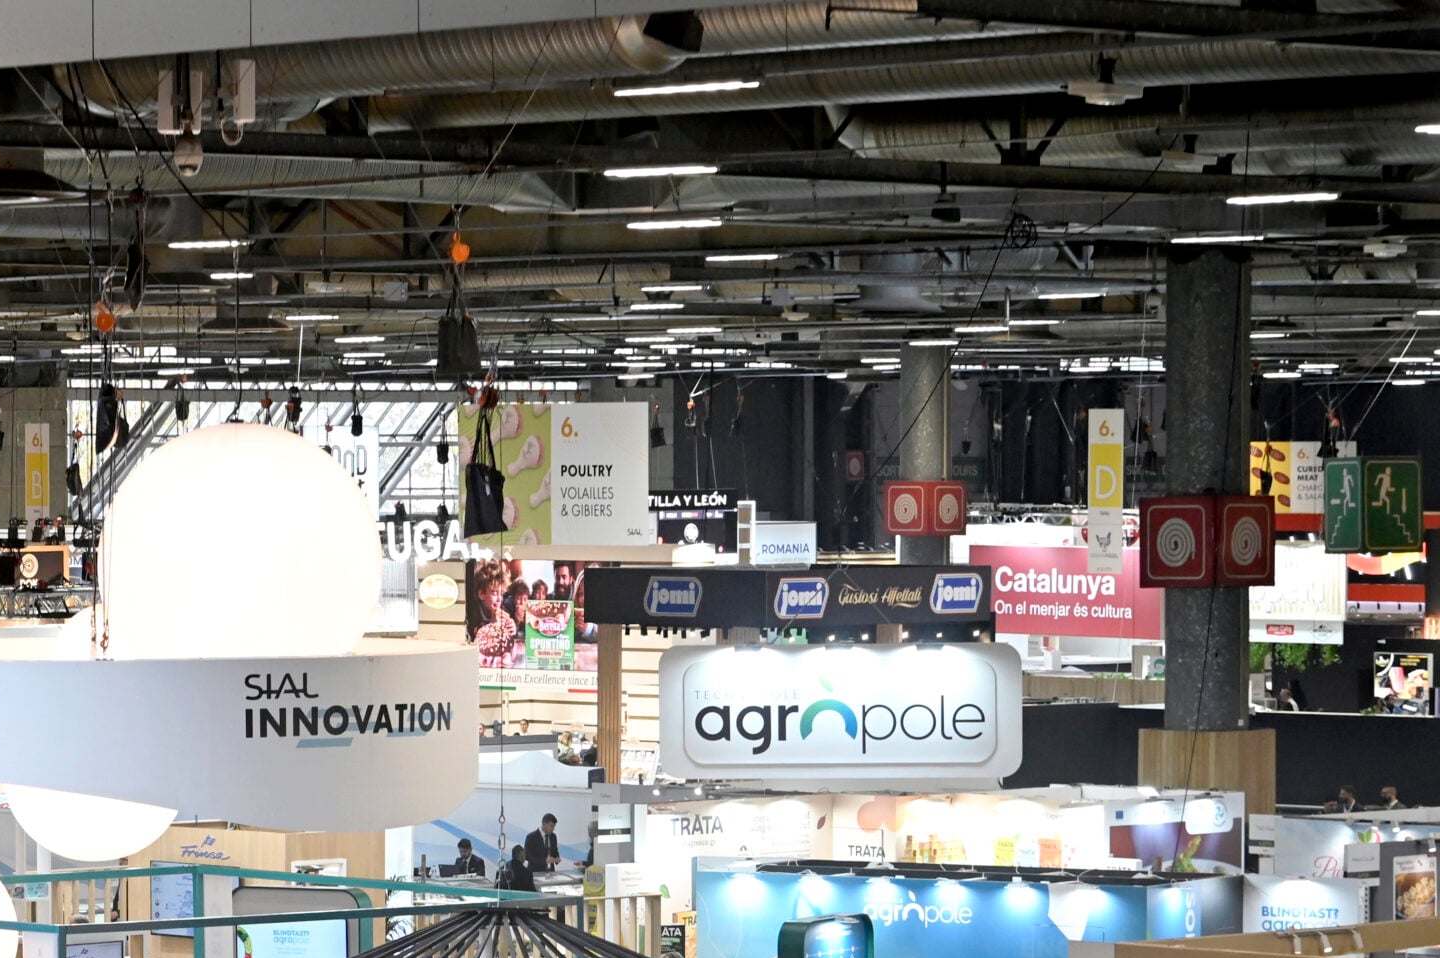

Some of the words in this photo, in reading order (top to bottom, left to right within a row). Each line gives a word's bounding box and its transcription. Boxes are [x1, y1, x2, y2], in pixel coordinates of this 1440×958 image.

[561, 416, 579, 438] 6.
[1098, 419, 1115, 438] 6.
[560, 463, 613, 479] POULTRY
[1296, 465, 1324, 473] CURED
[1296, 474, 1318, 482] MEAT
[31, 470, 43, 499] B
[1095, 465, 1119, 500] D
[560, 486, 614, 501] VOLAILLES
[682, 494, 692, 507] Y
[694, 490, 728, 508] LEÓN
[561, 504, 569, 518] &
[572, 503, 613, 518] GIBIERS
[627, 527, 643, 536] SIAL
[761, 542, 810, 556] ROMANIA
[651, 580, 696, 606] jomi
[937, 577, 977, 604] jomi
[994, 564, 1116, 601] Catalunya
[781, 580, 825, 607] jomi
[994, 599, 1014, 615] On
[1017, 599, 1027, 615] el
[1030, 601, 1071, 620] menjar
[1074, 601, 1088, 617] és
[1091, 603, 1133, 619] cultura
[530, 637, 571, 651] SPUNTINO
[244, 672, 320, 701] SIAL
[495, 672, 522, 684] Italian
[524, 673, 566, 686] Excellence
[567, 674, 589, 685] since
[244, 700, 452, 739] INNOVATION
[694, 694, 987, 756] agropole
[862, 896, 973, 929] agropole
